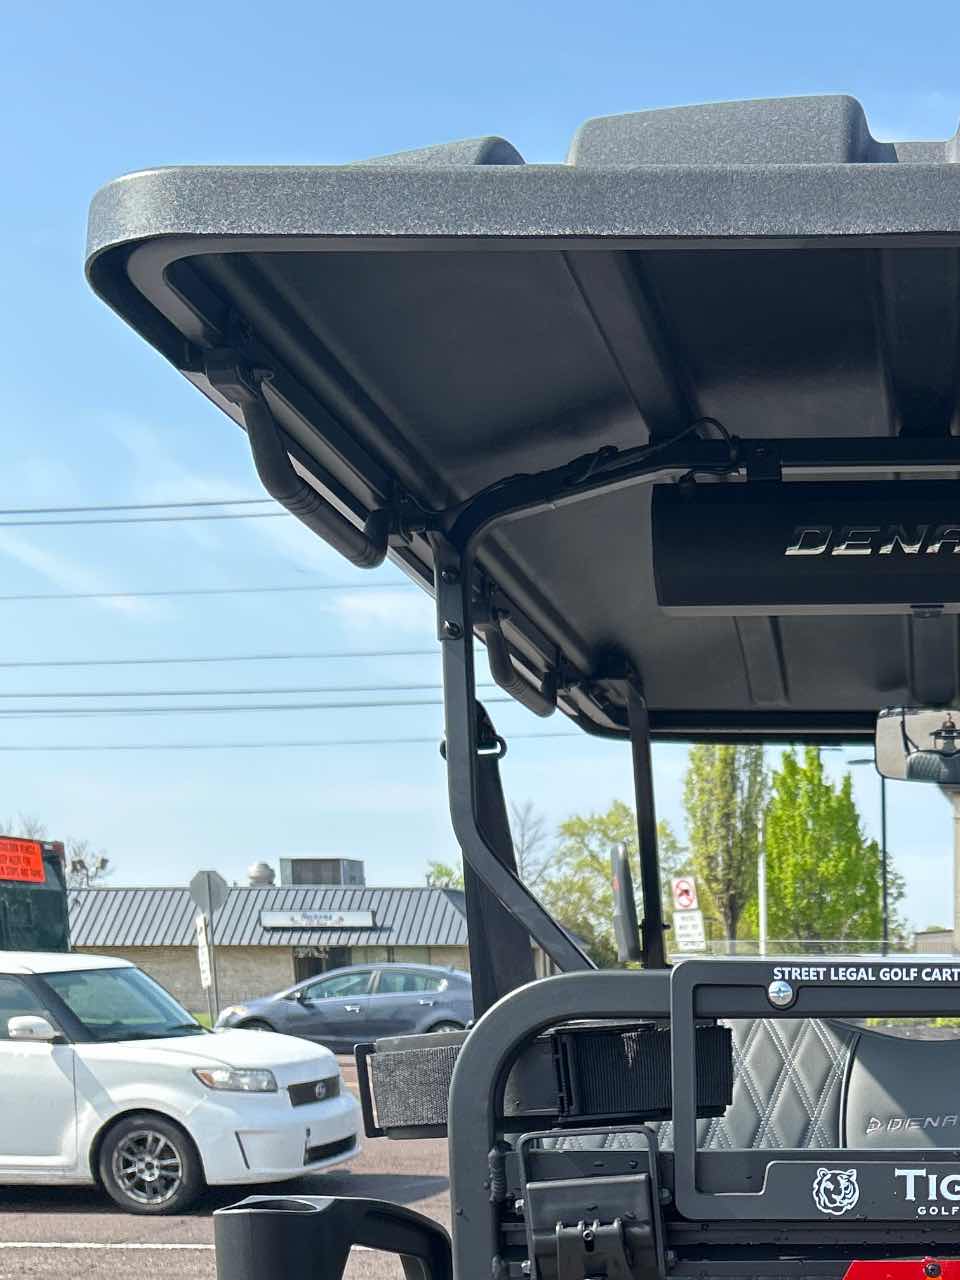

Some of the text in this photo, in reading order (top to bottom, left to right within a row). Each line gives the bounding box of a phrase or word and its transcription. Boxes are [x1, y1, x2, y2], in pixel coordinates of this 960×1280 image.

[773, 967, 826, 981] STREET
[830, 967, 876, 981] LEGAL
[880, 968, 918, 981] GOLF
[917, 1206, 960, 1216] GOLF
